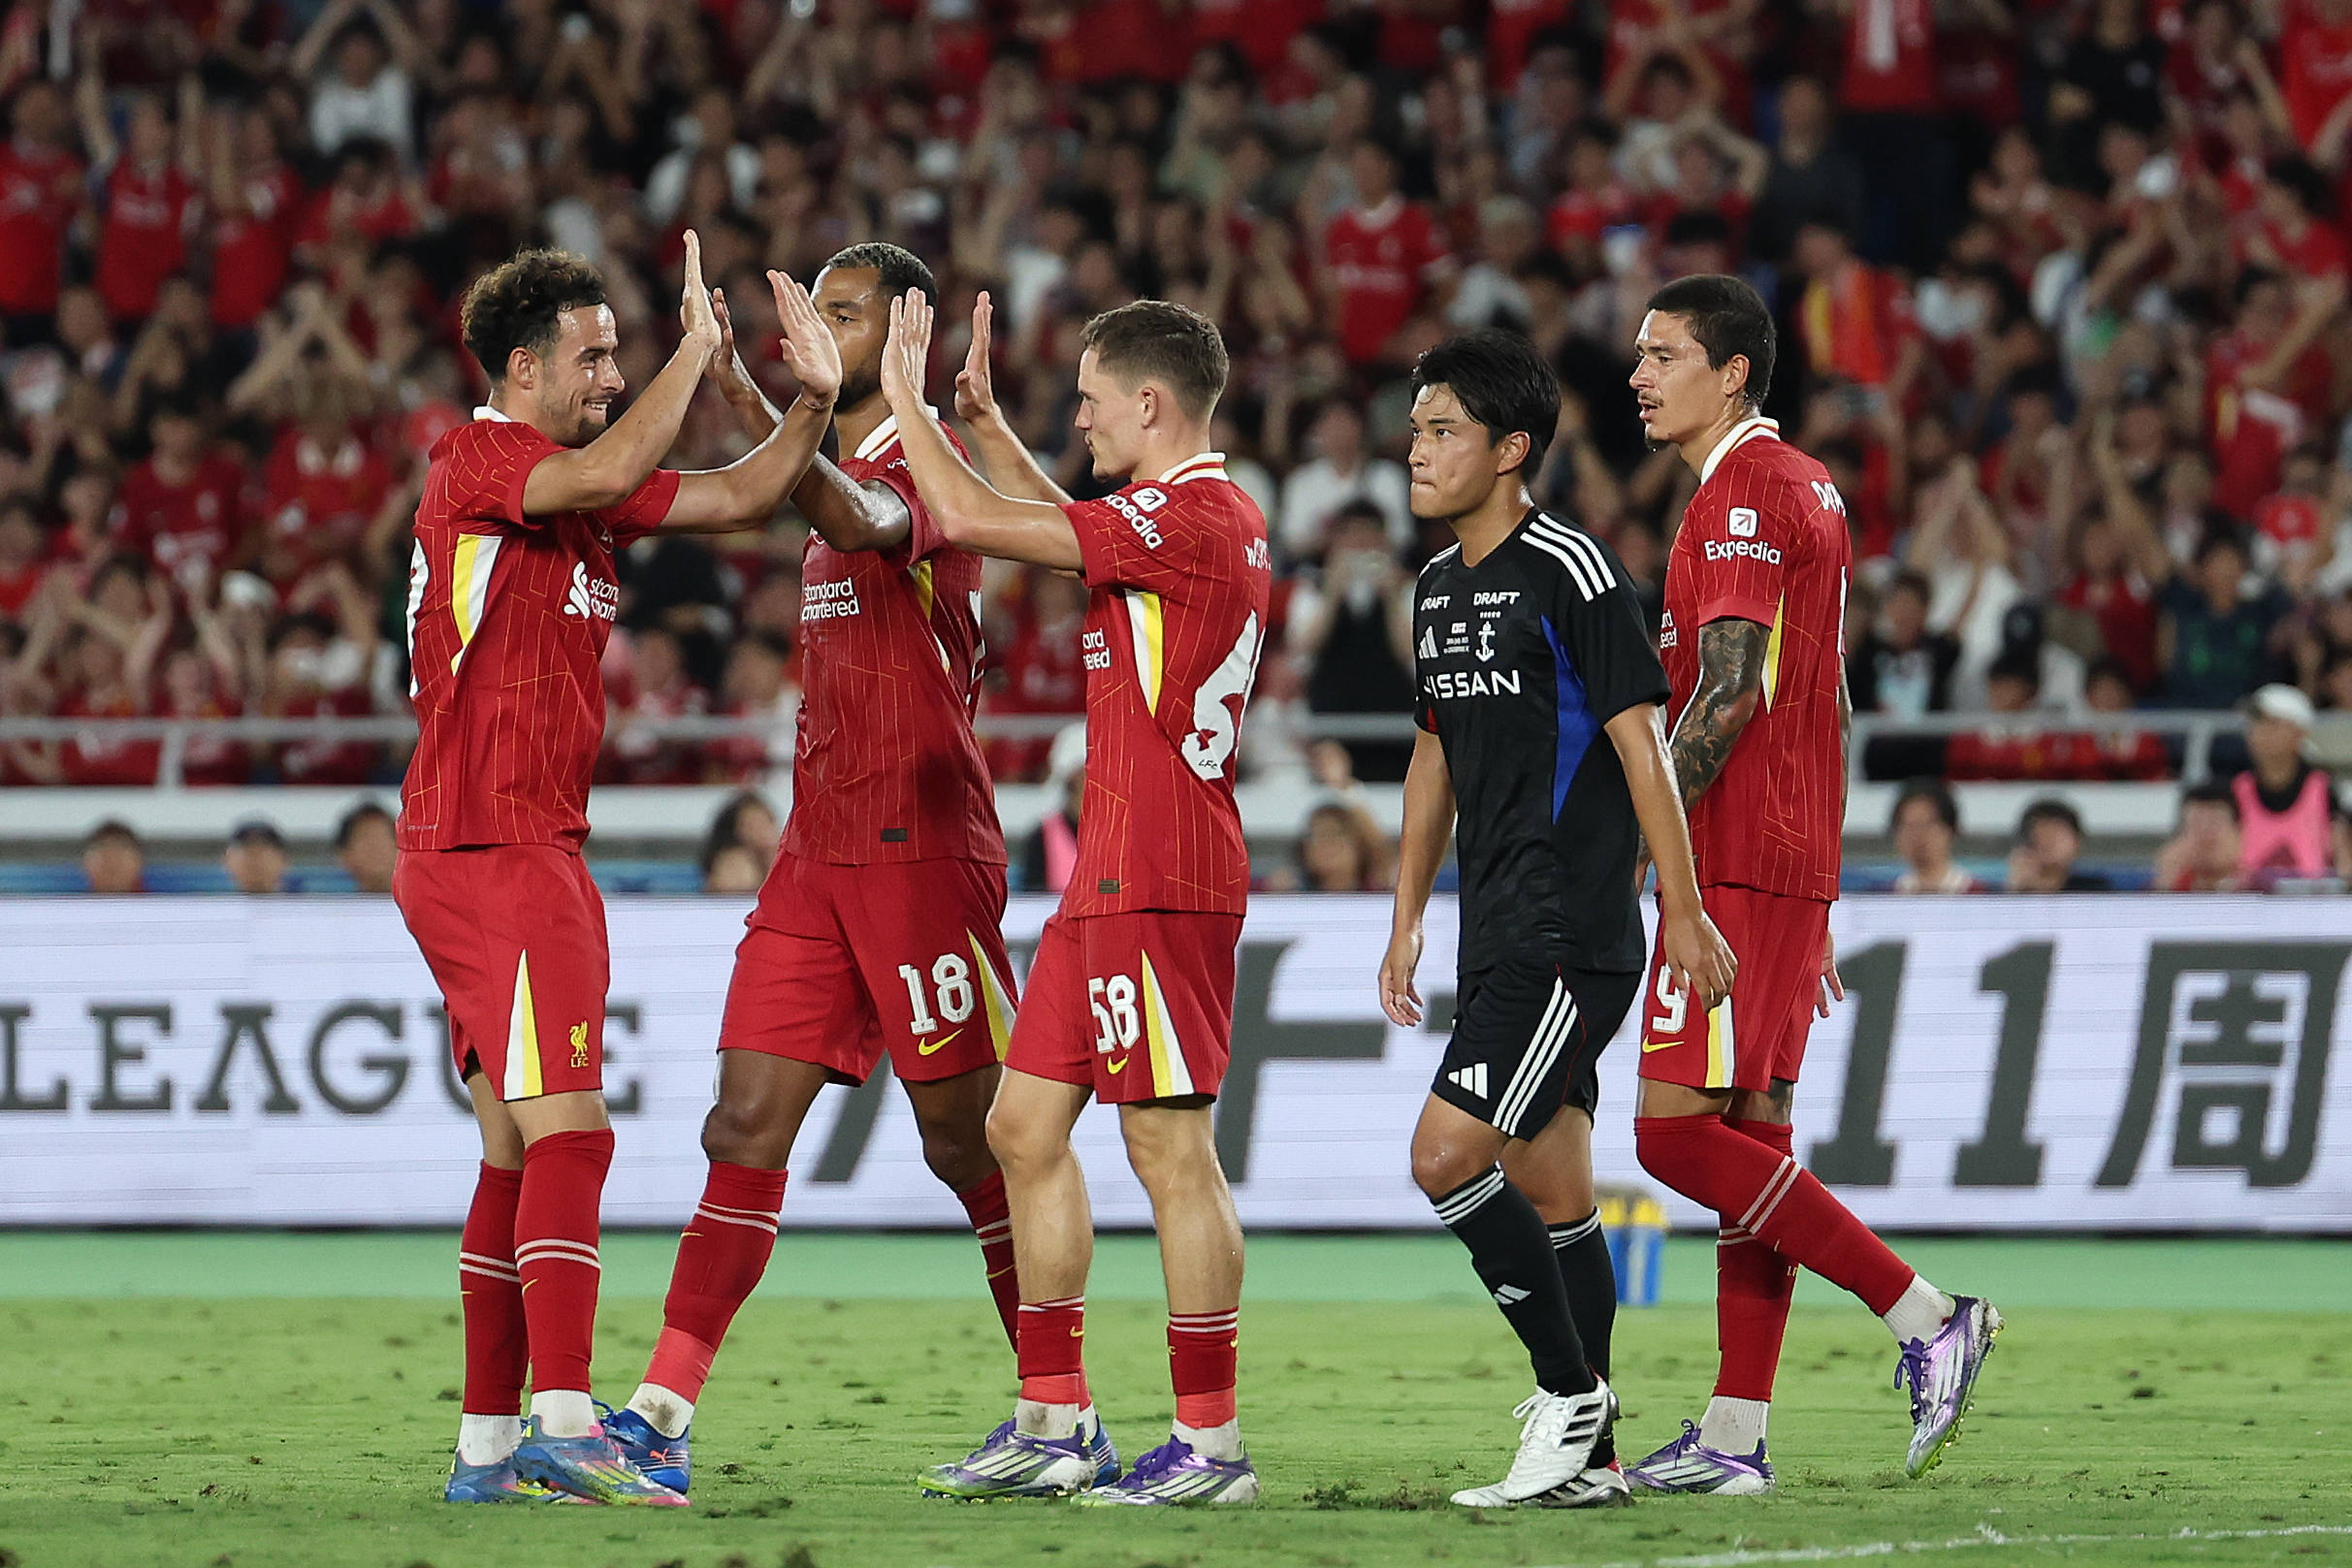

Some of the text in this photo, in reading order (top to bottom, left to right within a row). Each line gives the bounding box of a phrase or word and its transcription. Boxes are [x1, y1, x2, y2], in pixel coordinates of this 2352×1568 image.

[1103, 494, 1164, 550] xpedia
[1704, 540, 1782, 565] Expedia
[1473, 592, 1521, 606] DRAFT
[898, 953, 976, 1036] 18
[1088, 974, 1141, 1054] 58
[570, 1057, 590, 1068] LFC
